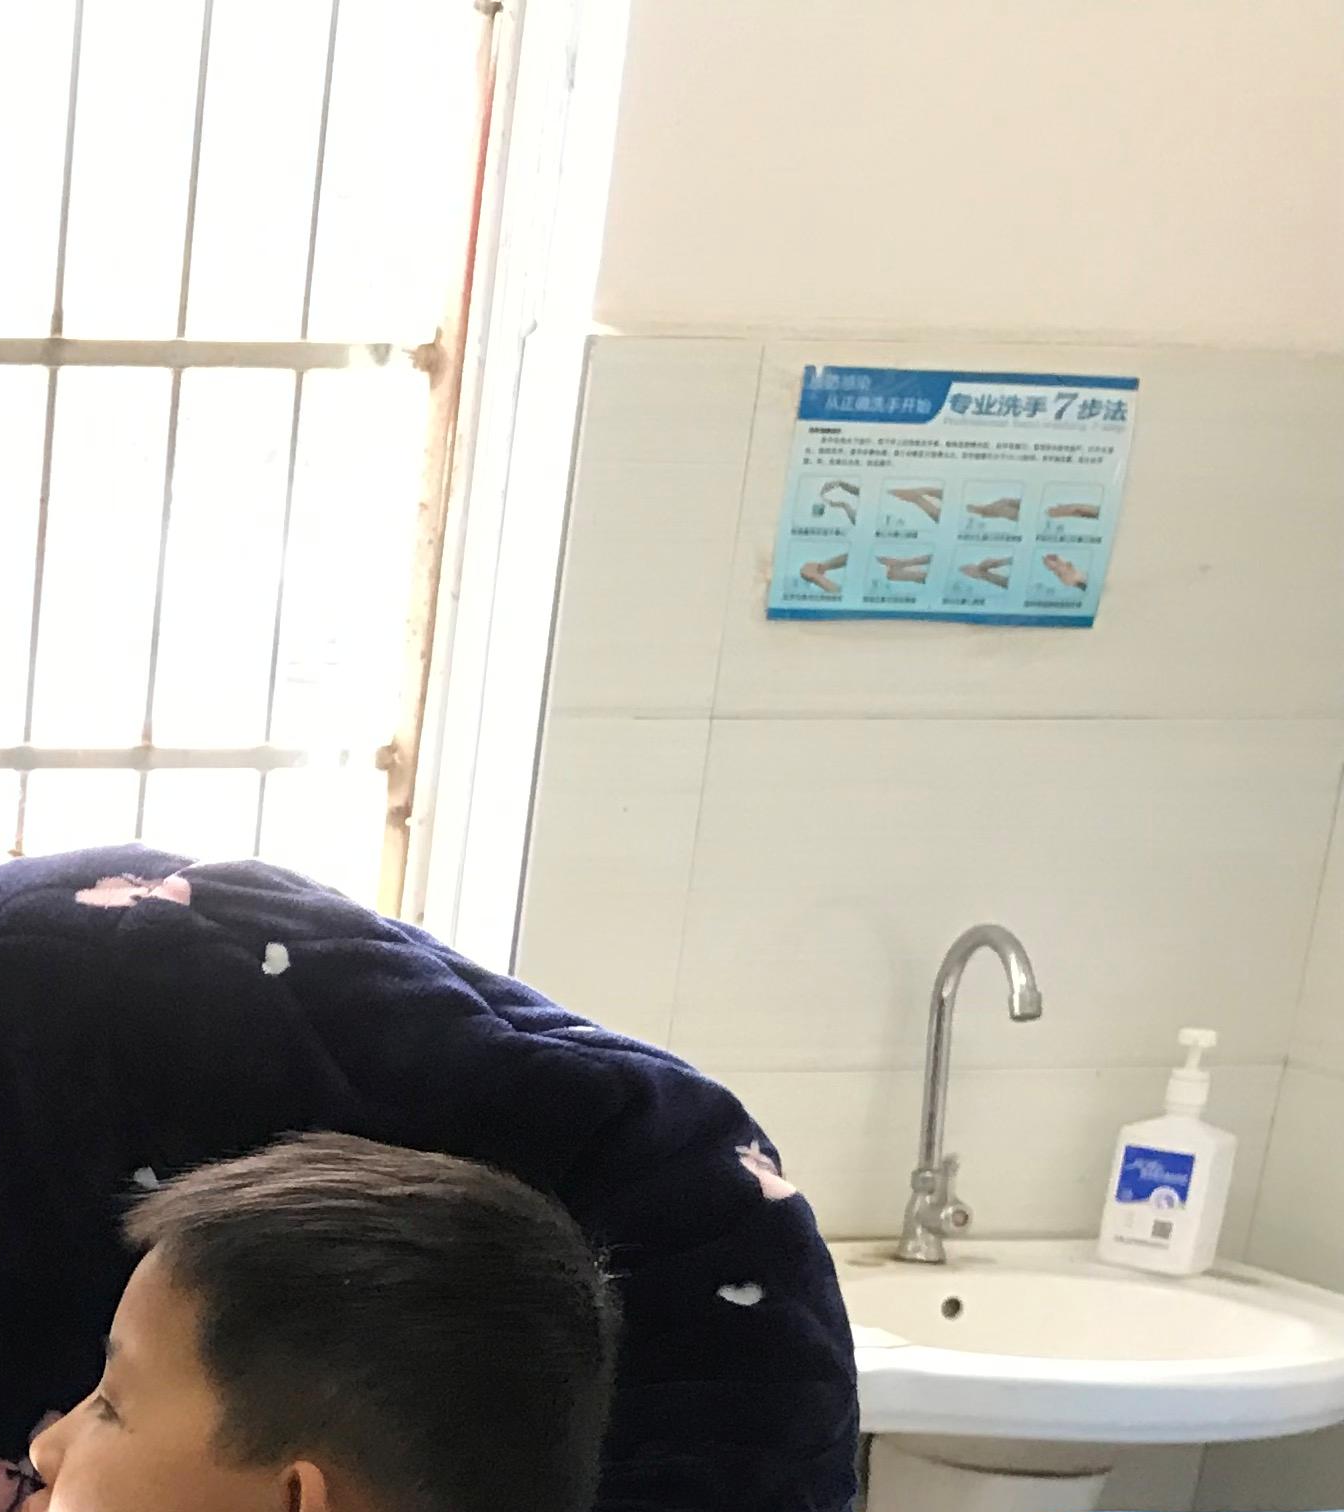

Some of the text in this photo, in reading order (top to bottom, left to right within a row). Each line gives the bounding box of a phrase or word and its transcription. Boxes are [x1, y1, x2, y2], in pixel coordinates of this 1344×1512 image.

[948, 391, 1128, 422] 专业洗手7步法
